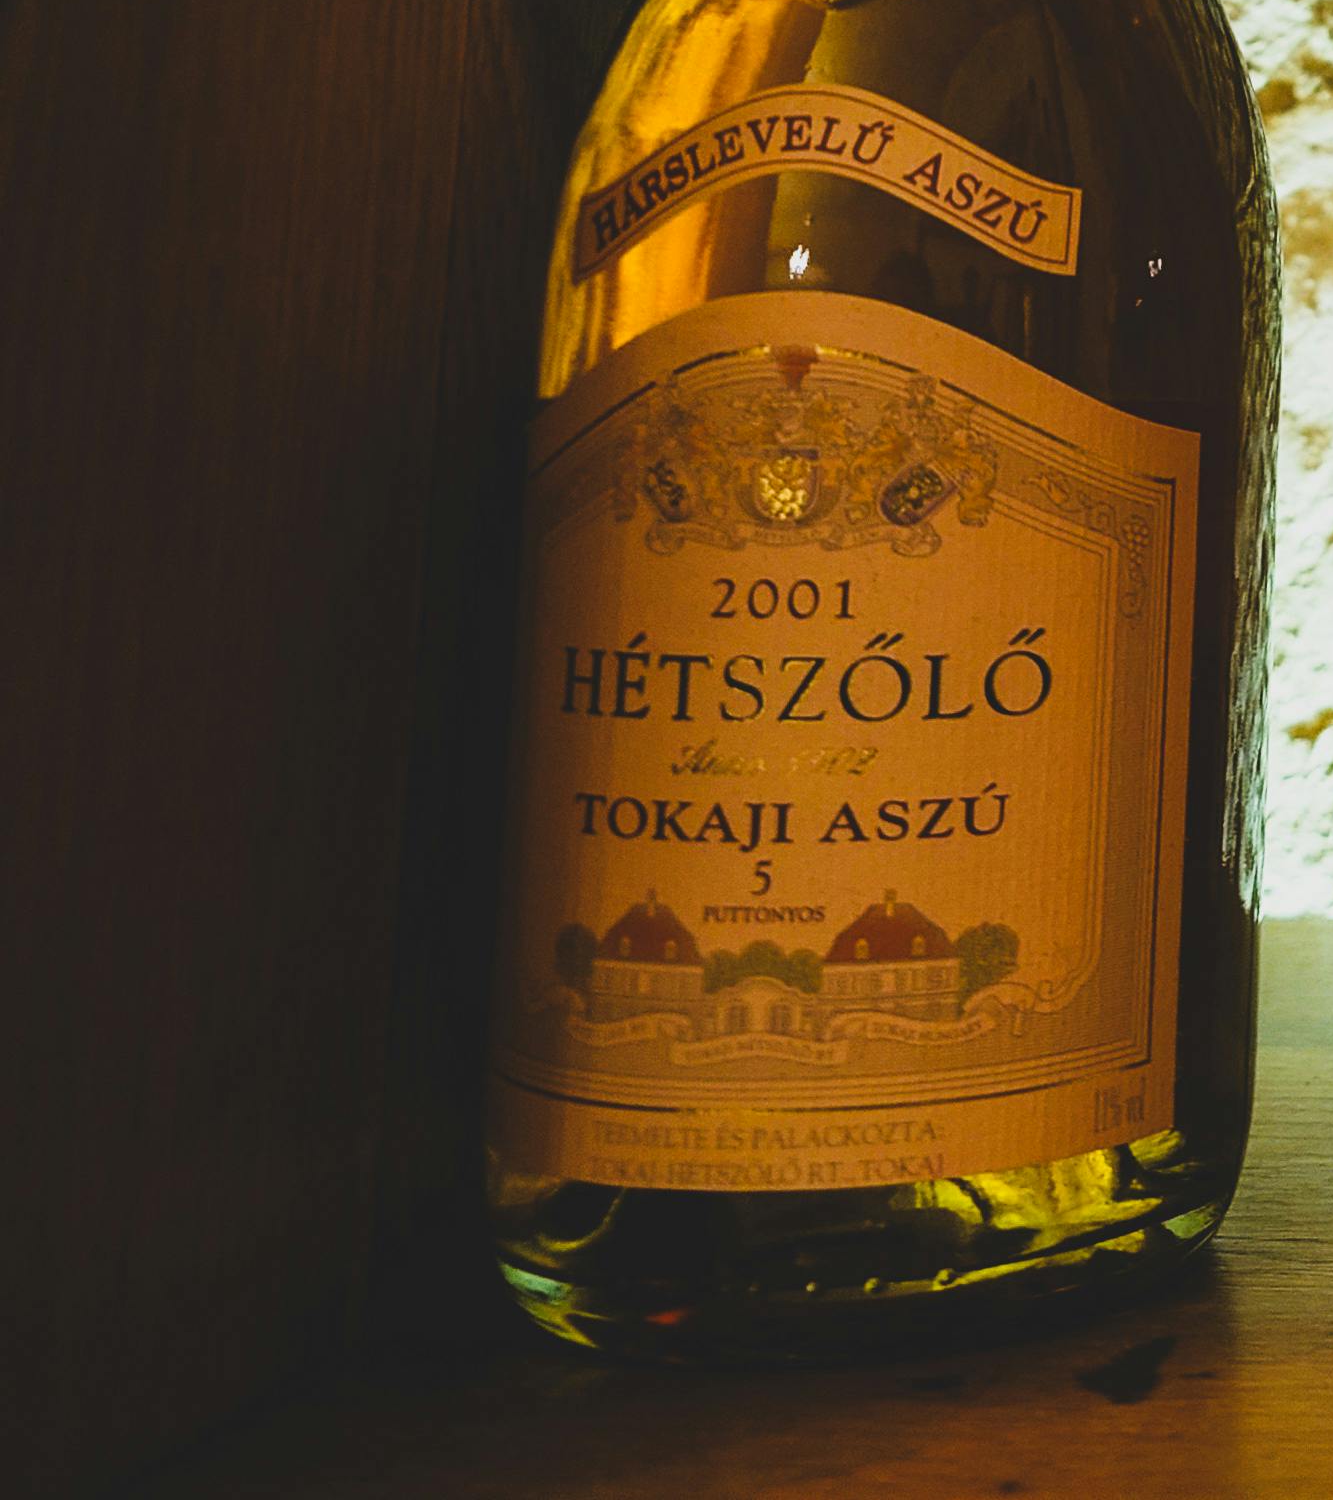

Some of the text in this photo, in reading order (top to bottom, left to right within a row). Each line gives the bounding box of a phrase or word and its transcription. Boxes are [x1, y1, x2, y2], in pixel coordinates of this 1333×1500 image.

[591, 113, 1049, 250] HÁRSLEVELŰ ASZÚ
[710, 577, 857, 621] 2001
[560, 627, 1054, 723] HÉTSZŐLŐ
[576, 782, 1011, 853] TOKAJI ASZÚ
[751, 859, 774, 897] 5
